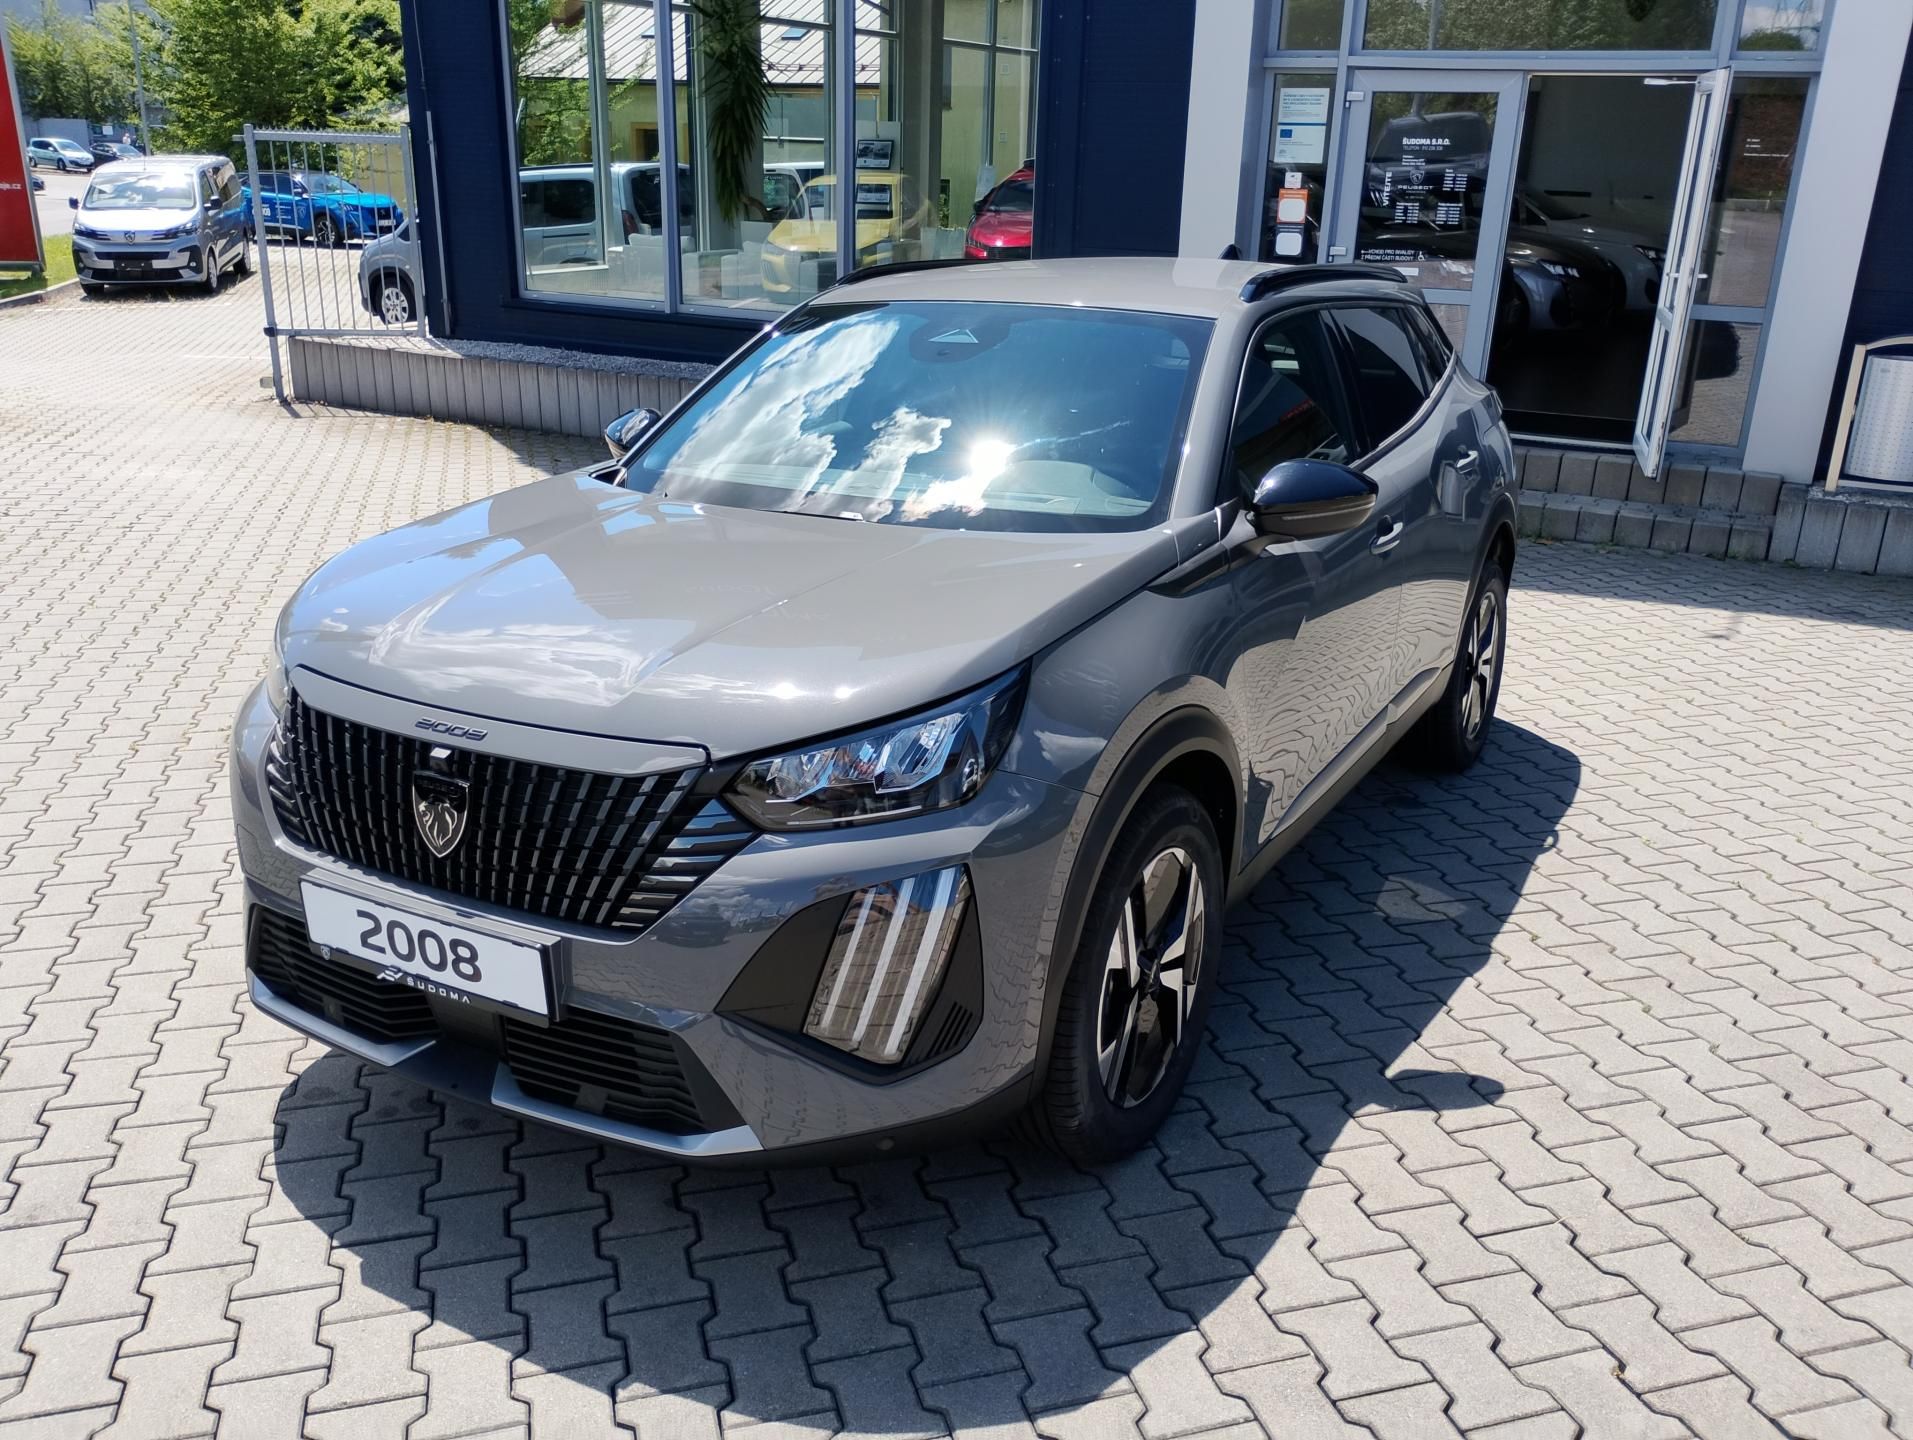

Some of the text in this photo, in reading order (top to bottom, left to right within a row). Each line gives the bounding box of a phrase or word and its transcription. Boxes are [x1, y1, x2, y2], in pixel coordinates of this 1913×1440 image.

[415, 716, 488, 742] 2008
[356, 909, 483, 983] 2008
[406, 975, 471, 1004] ŠUDOMA
